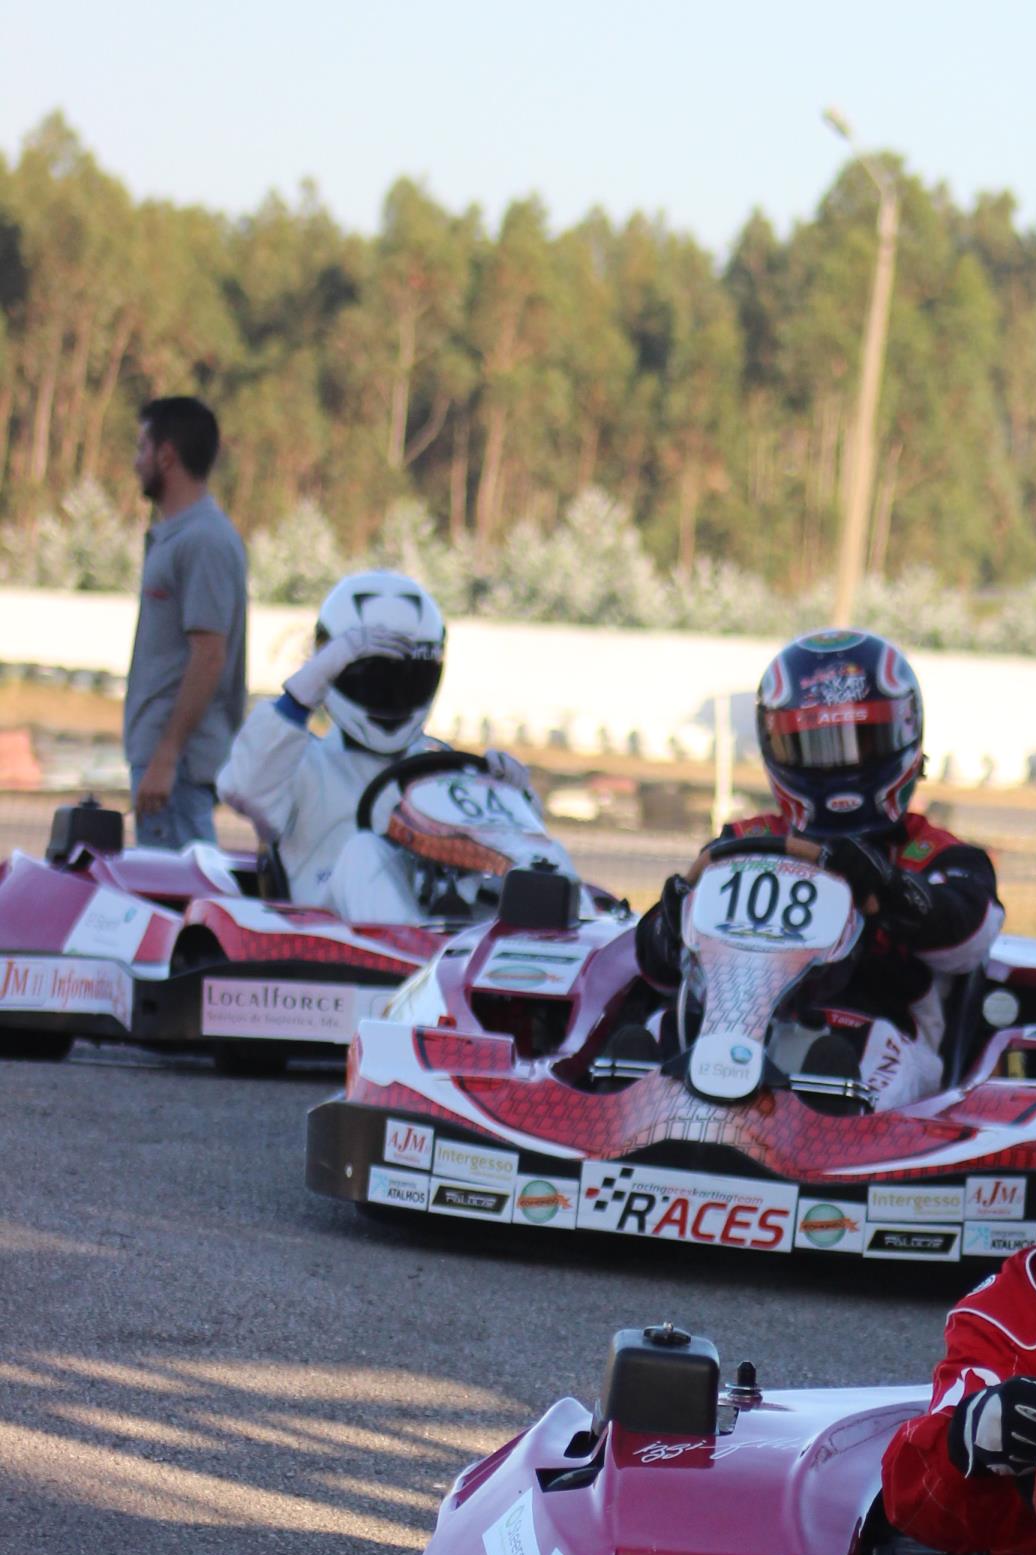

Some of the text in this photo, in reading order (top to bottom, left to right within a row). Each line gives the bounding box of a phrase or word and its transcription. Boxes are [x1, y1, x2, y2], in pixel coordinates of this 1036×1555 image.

[718, 871, 818, 930] 108
[437, 1146, 514, 1173] Intergesso
[616, 1191, 790, 1250] RACES
[872, 1191, 960, 1210] Intergesso
